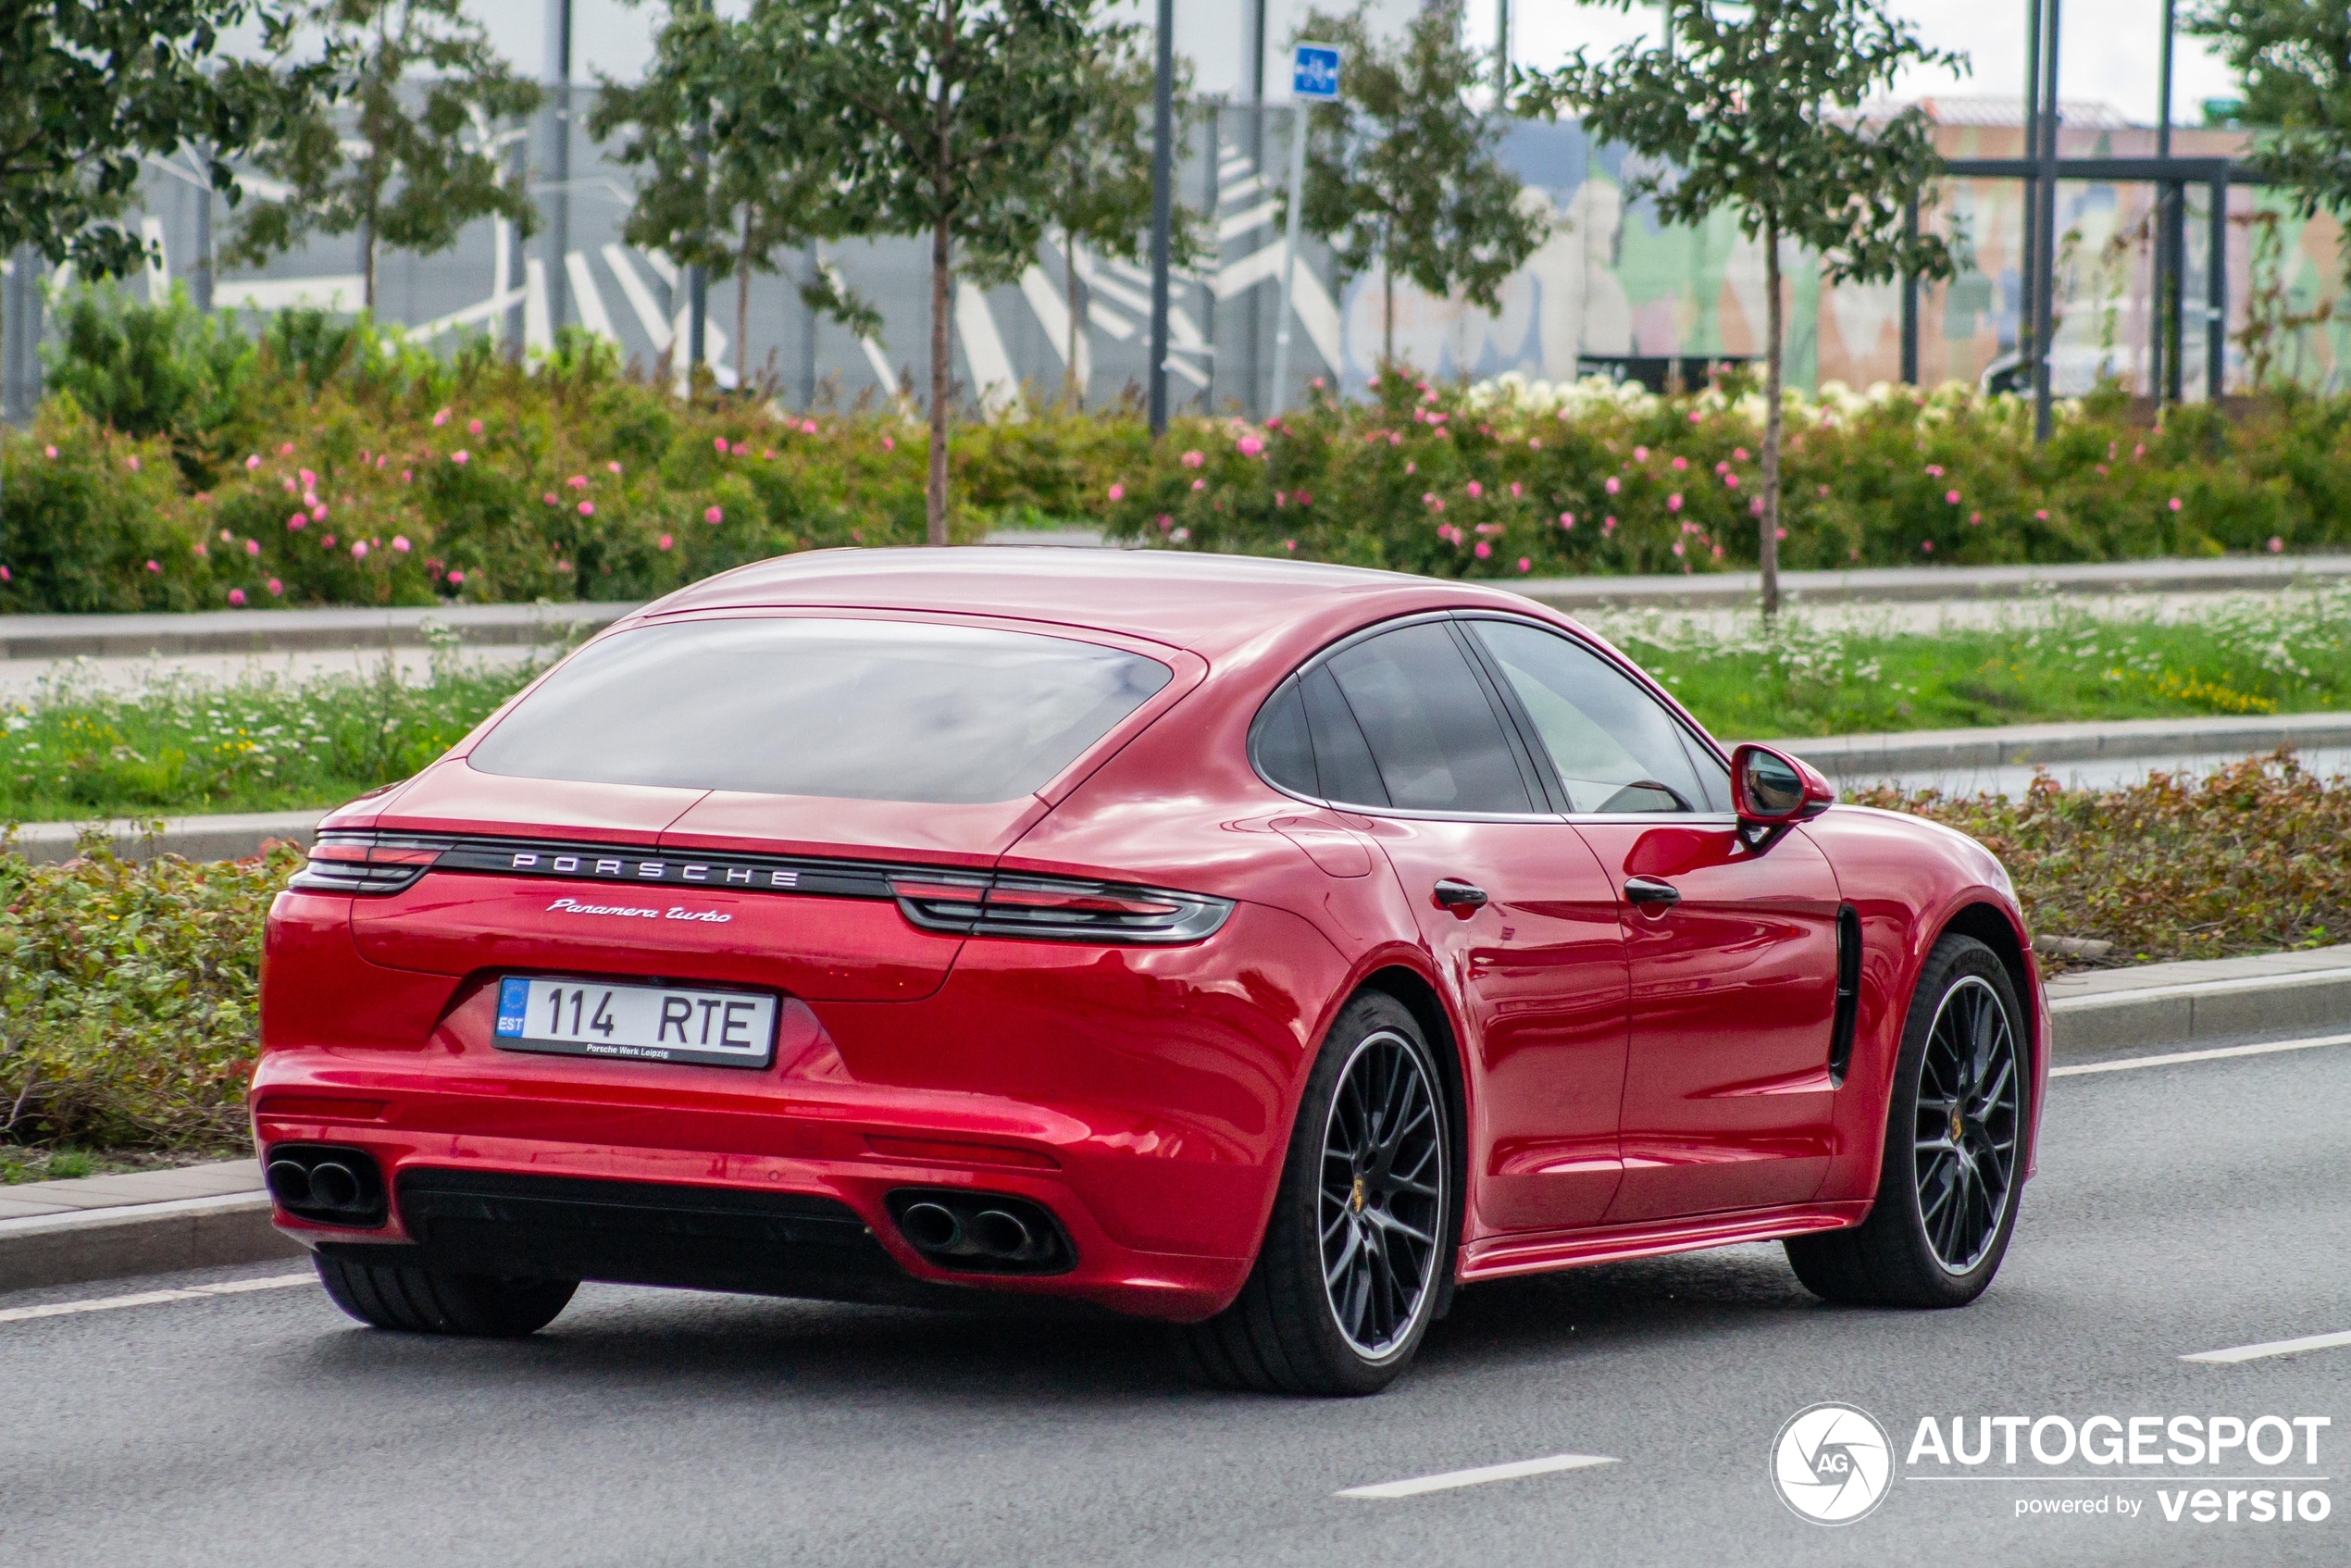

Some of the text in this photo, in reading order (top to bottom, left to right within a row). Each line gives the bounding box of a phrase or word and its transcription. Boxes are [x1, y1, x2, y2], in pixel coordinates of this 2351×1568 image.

[512, 853, 798, 886] PORSCHE
[545, 899, 659, 918] Panamera
[498, 1016, 524, 1031] EST
[548, 988, 756, 1048] 114 RTE
[586, 1043, 668, 1059] Porsche Werk Leipzig
